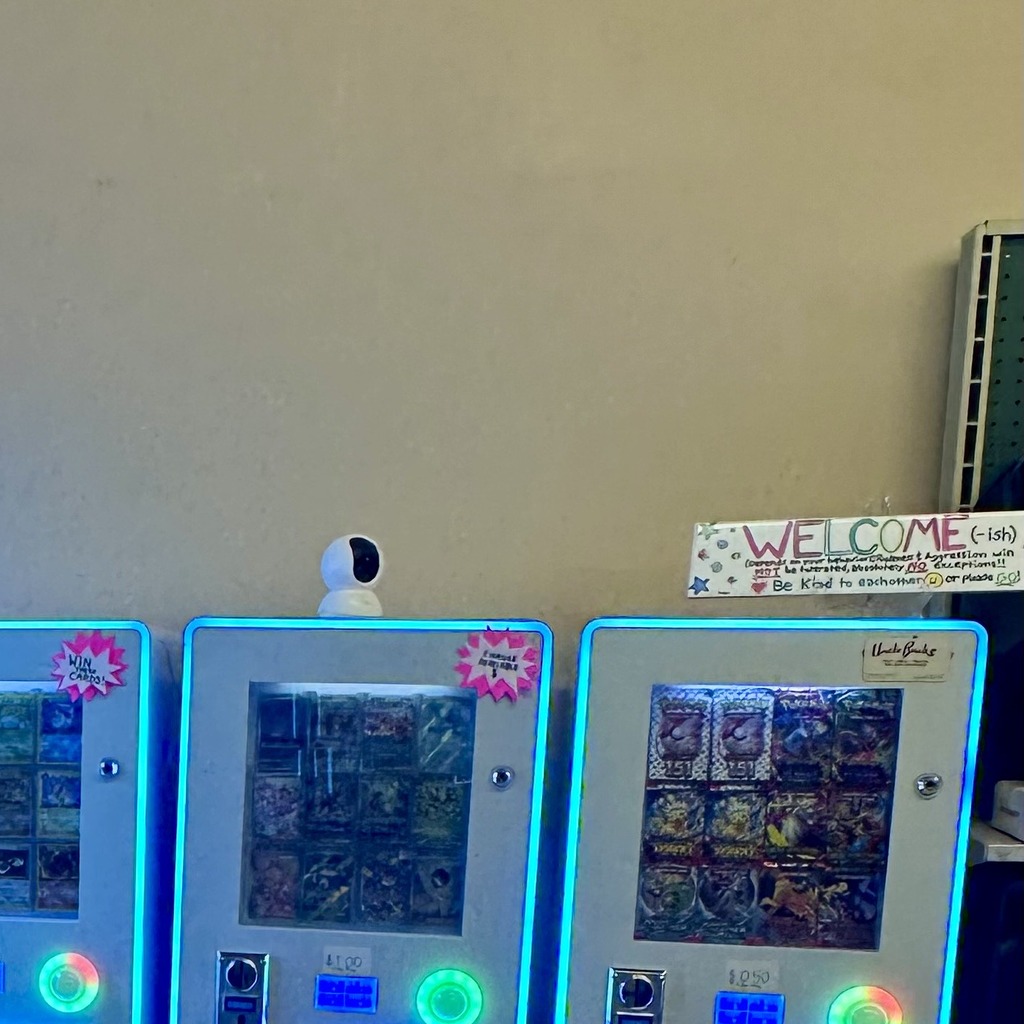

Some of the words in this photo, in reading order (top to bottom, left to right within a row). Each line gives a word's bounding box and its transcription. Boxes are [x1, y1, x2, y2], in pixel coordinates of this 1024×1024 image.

[742, 514, 969, 559] WELCOME
[773, 580, 793, 591] Be
[68, 654, 92, 671] WIN
